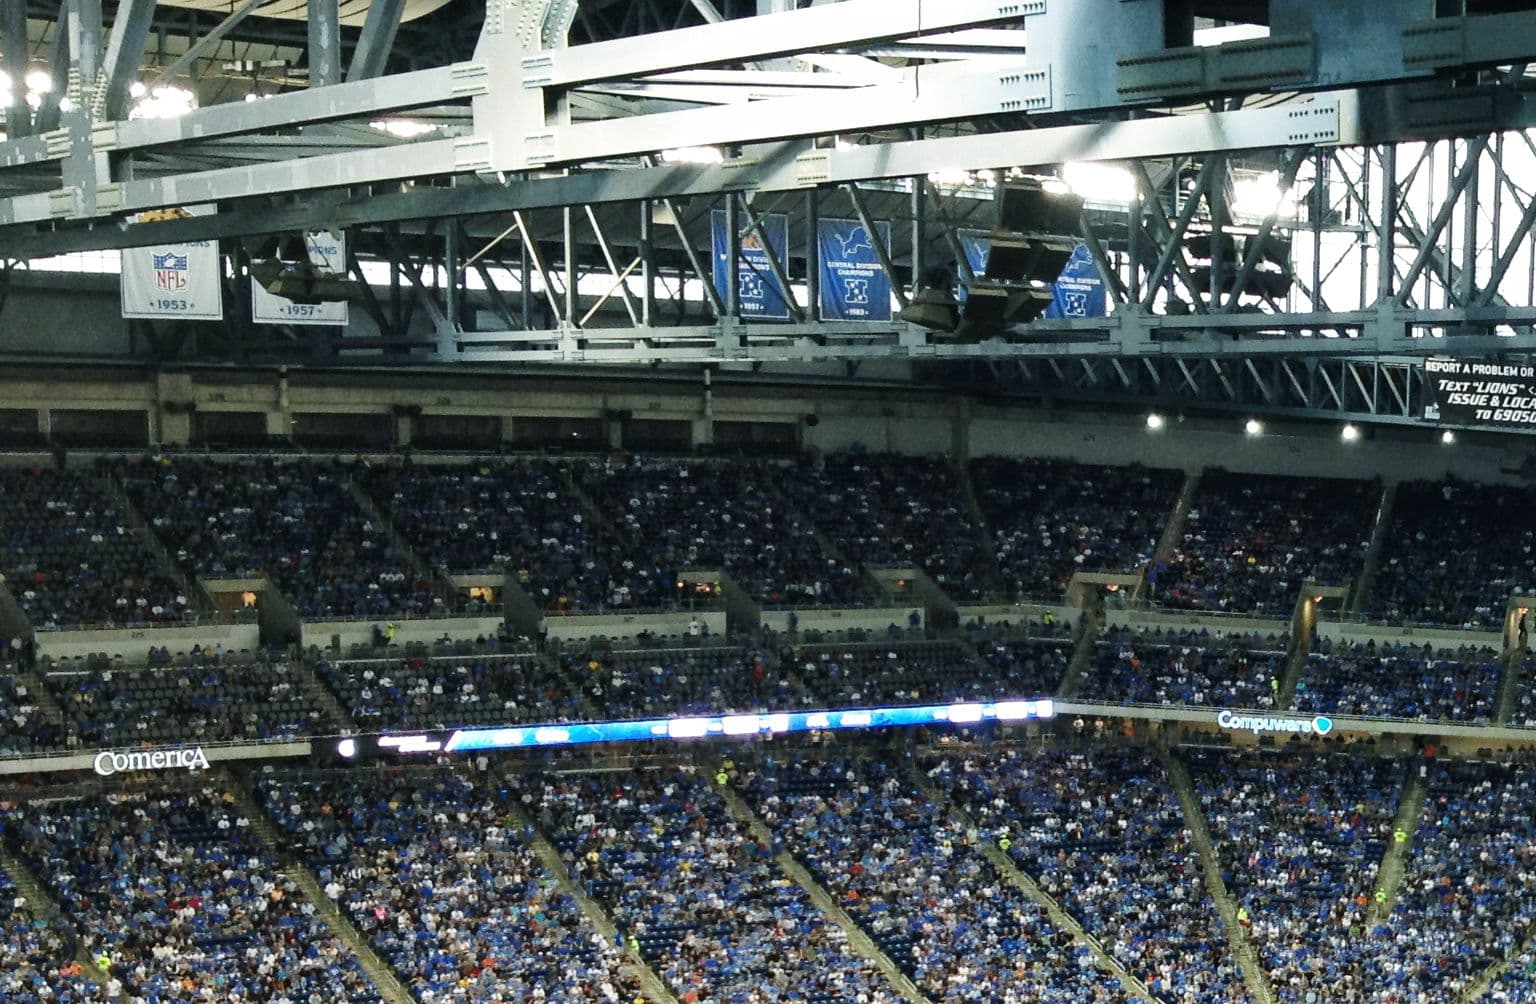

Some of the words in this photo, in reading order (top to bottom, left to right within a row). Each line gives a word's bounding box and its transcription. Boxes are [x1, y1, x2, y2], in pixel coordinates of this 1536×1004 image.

[157, 271, 186, 291] NFL
[157, 300, 187, 310] 1953
[287, 306, 314, 315] 1957
[1425, 362, 1461, 373] REPORT
[1463, 364, 1471, 374] A
[1472, 365, 1519, 377] PROBLEM
[1520, 366, 1534, 377] OR
[1438, 380, 1471, 392] TEXT
[1473, 382, 1525, 395] "LIONS"
[1448, 393, 1488, 406] ISSUE
[1490, 396, 1500, 407] &
[1218, 710, 1311, 734] Compuware
